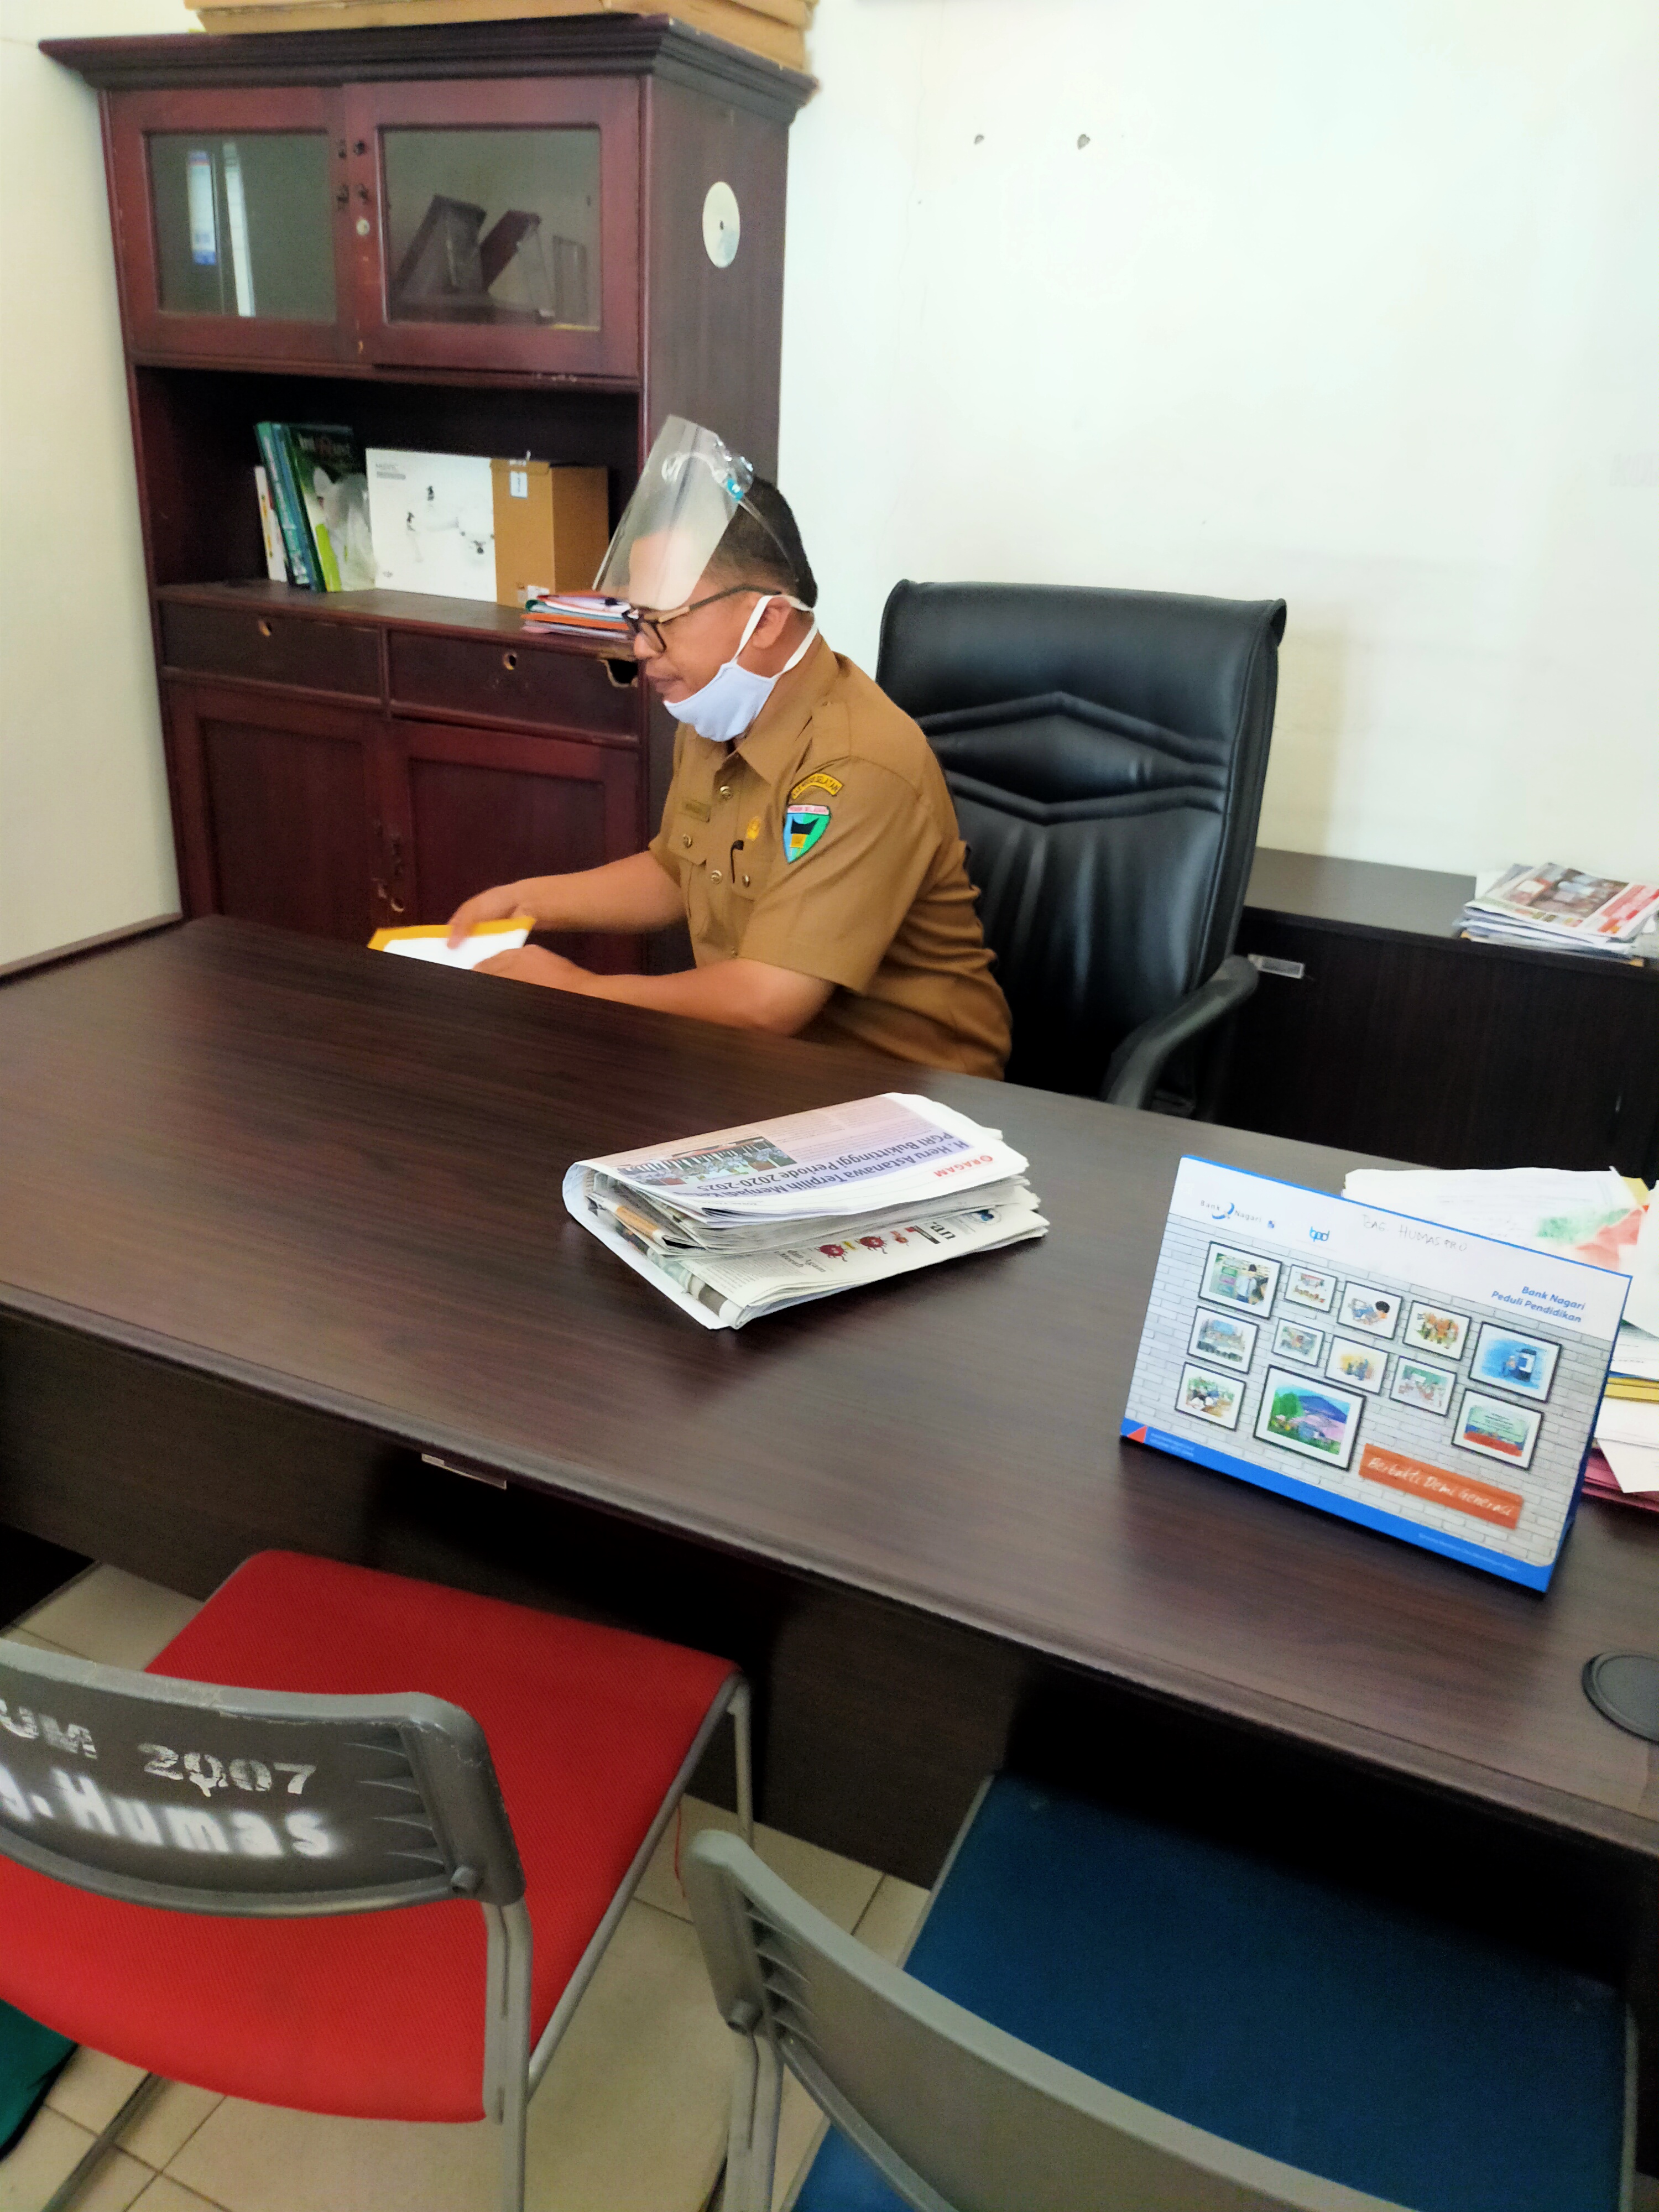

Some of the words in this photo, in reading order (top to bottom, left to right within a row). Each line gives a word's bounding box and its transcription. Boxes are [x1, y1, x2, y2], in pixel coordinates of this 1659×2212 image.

[920, 1131, 954, 1146] PGRI
[948, 1140, 969, 1150] H.
[836, 1141, 920, 1168] Bukittinggi
[914, 1145, 953, 1159] Heru
[780, 1161, 839, 1179] Periode
[843, 1156, 917, 1178] Astanawa
[697, 1175, 781, 1192] 2020-2025
[723, 1185, 789, 1197] Menjadi
[786, 1173, 848, 1191] Terpilih
[1201, 1201, 1220, 1211] Bank
[1235, 1211, 1261, 1223] Nagari
[1491, 1291, 1524, 1305] Peduli
[1524, 1300, 1582, 1322] Pendidikan
[1522, 1286, 1548, 1299] Bank
[1550, 1294, 1585, 1310] Nagari
[1423, 1475, 1455, 1496] Demi
[137, 1743, 317, 1797] 2007
